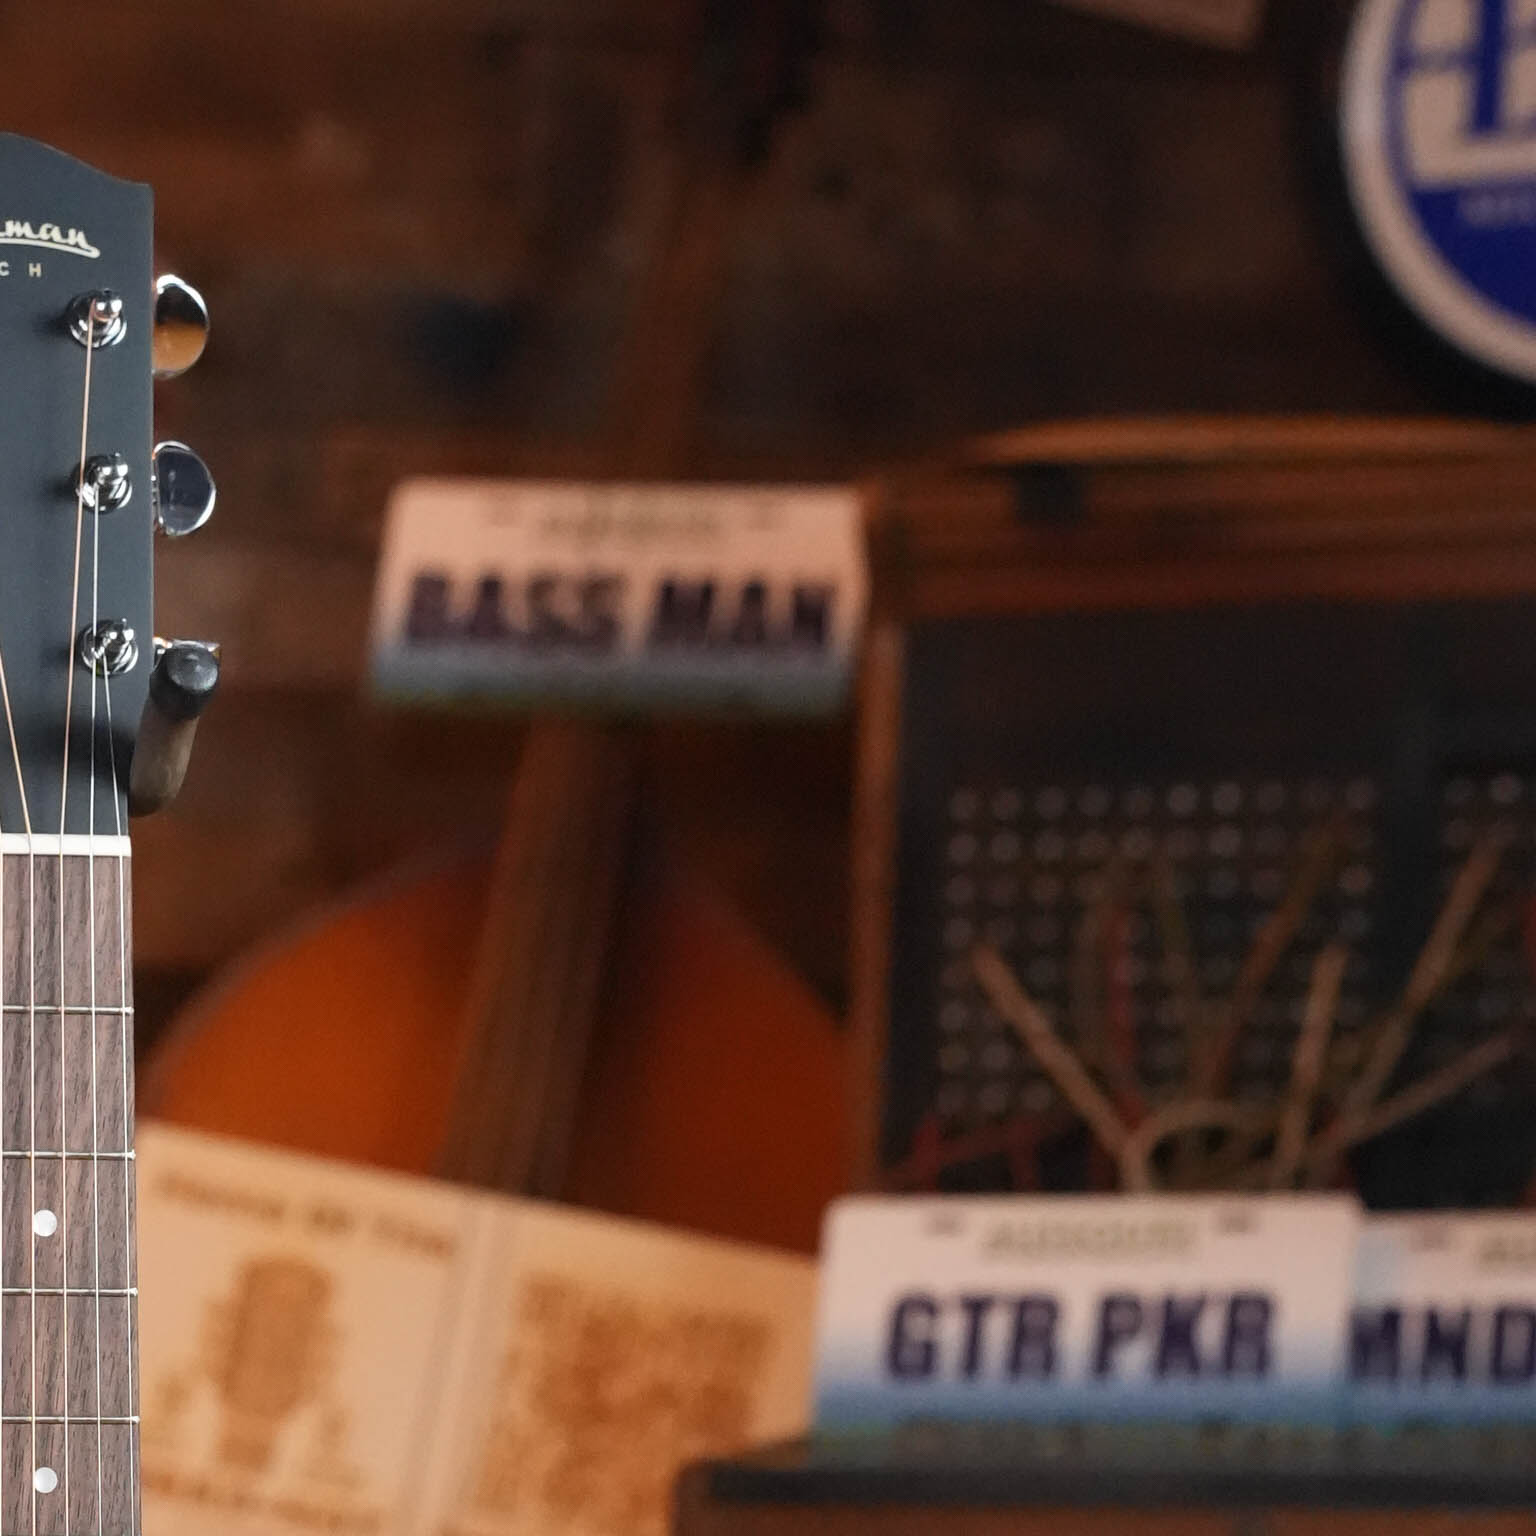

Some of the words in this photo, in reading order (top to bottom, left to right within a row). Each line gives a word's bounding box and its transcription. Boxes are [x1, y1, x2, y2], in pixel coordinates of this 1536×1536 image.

[406, 571, 624, 650] BASS
[646, 577, 836, 652] MAN
[885, 1291, 1062, 1384] GTR
[1090, 1291, 1277, 1384] PKR
